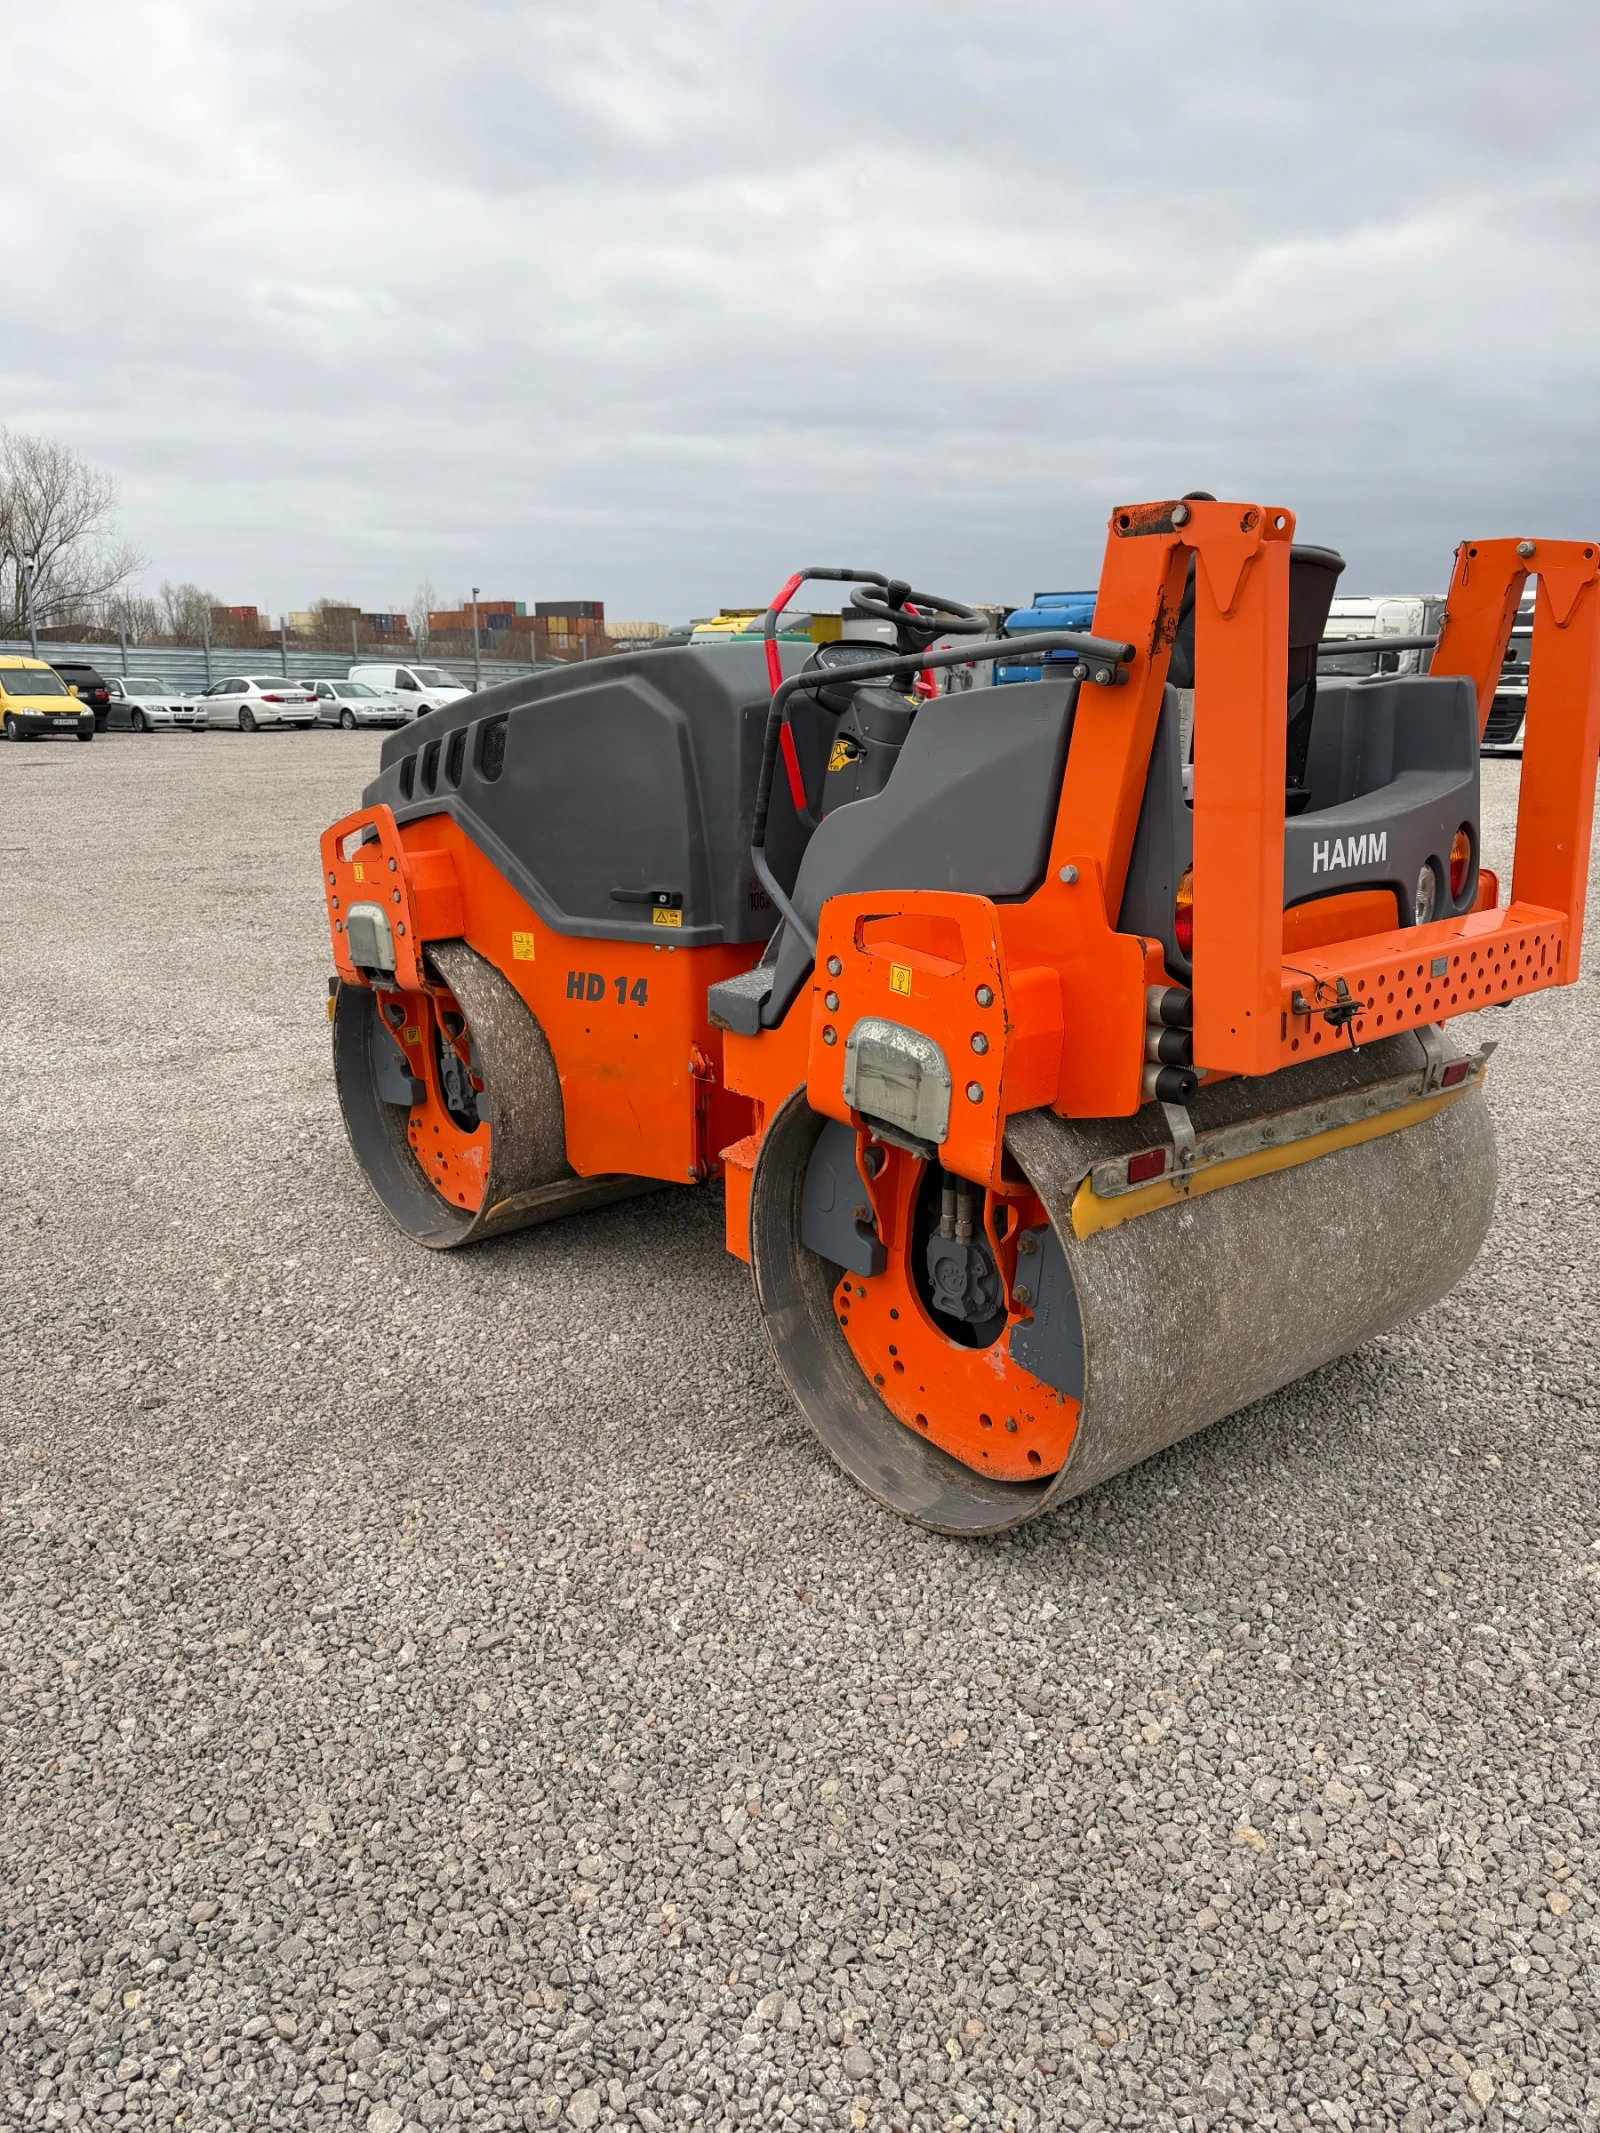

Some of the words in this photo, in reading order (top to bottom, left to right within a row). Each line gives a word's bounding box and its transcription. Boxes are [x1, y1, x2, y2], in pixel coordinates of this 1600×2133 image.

[1312, 831, 1387, 874] HAMM
[566, 971, 606, 1002] HD
[614, 976, 648, 1007] 14
